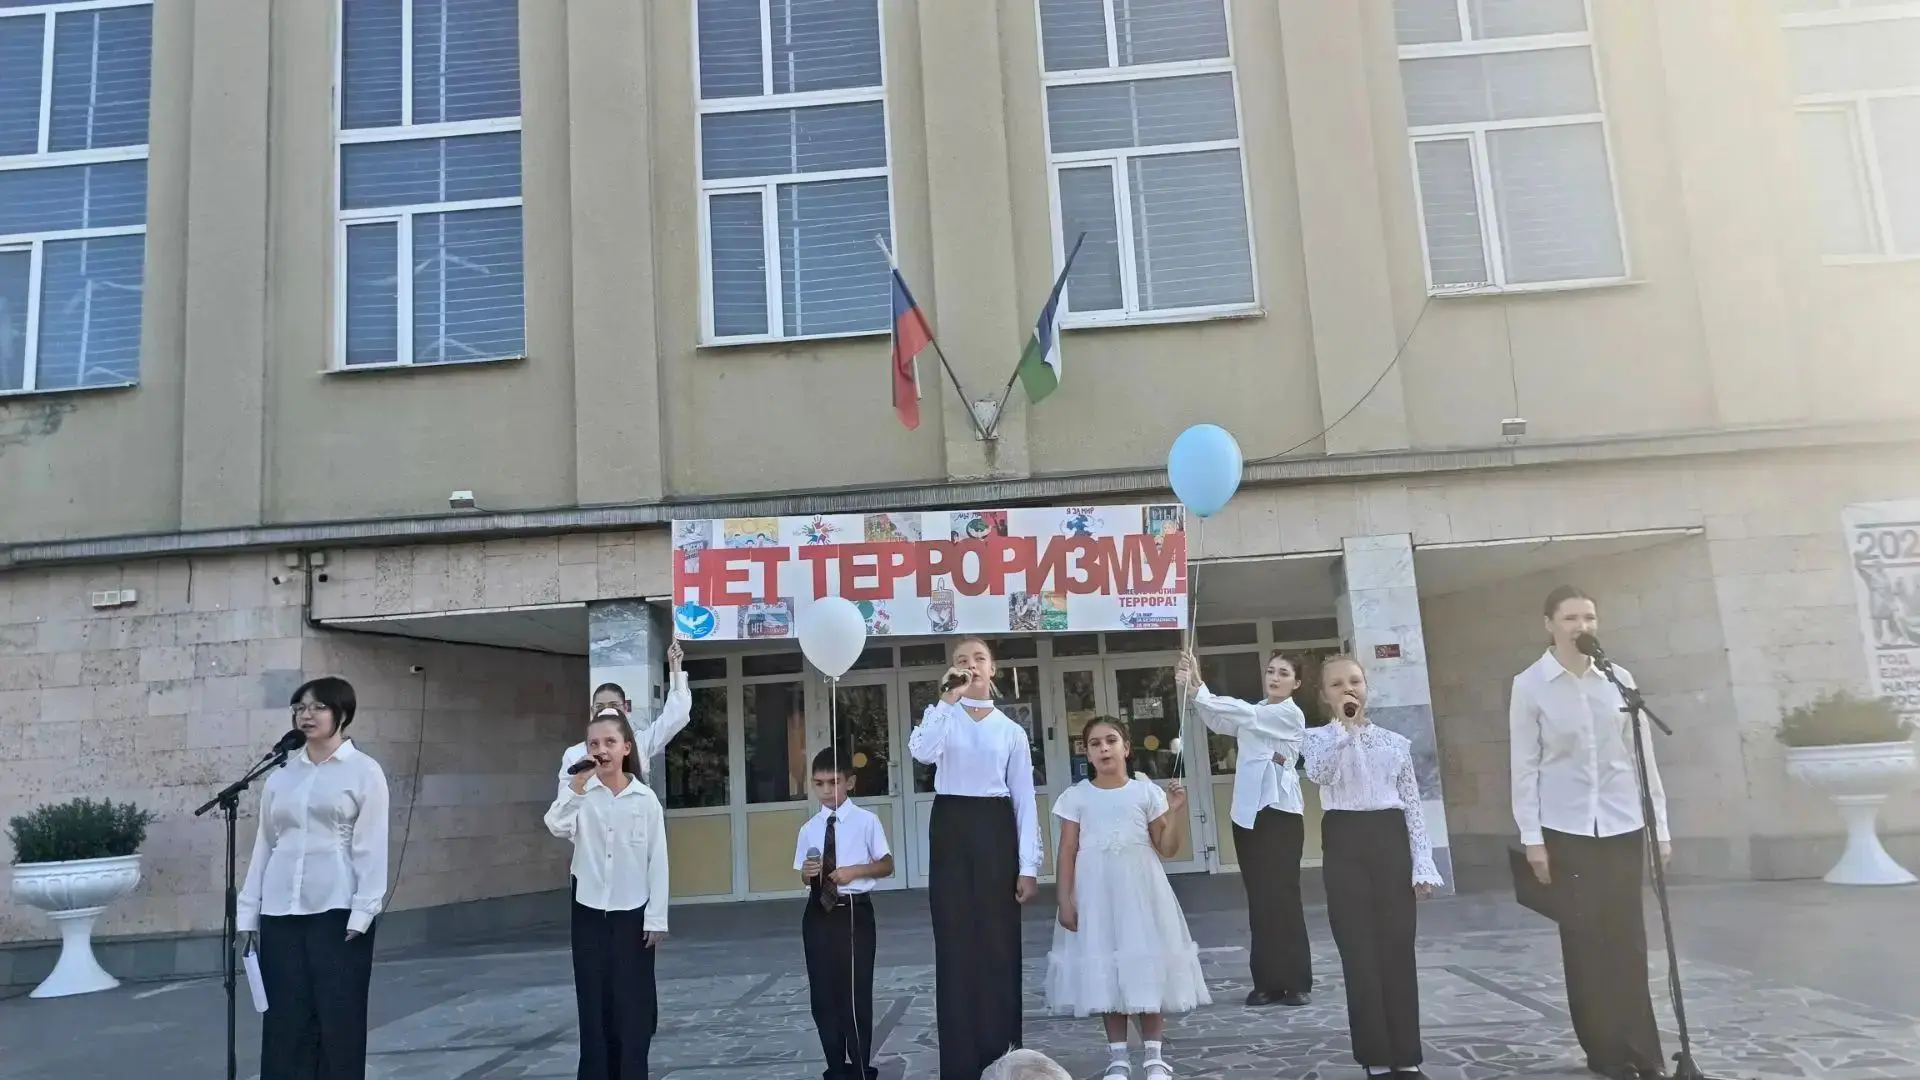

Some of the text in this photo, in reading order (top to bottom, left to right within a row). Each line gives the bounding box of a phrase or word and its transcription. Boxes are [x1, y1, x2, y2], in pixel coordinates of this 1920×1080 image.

[674, 531, 1187, 606] НЕТ ТЕРРОРИЗМУ!
[1119, 597, 1177, 607] ТЕРРОРА!
[1876, 653, 1910, 665] ГОД
